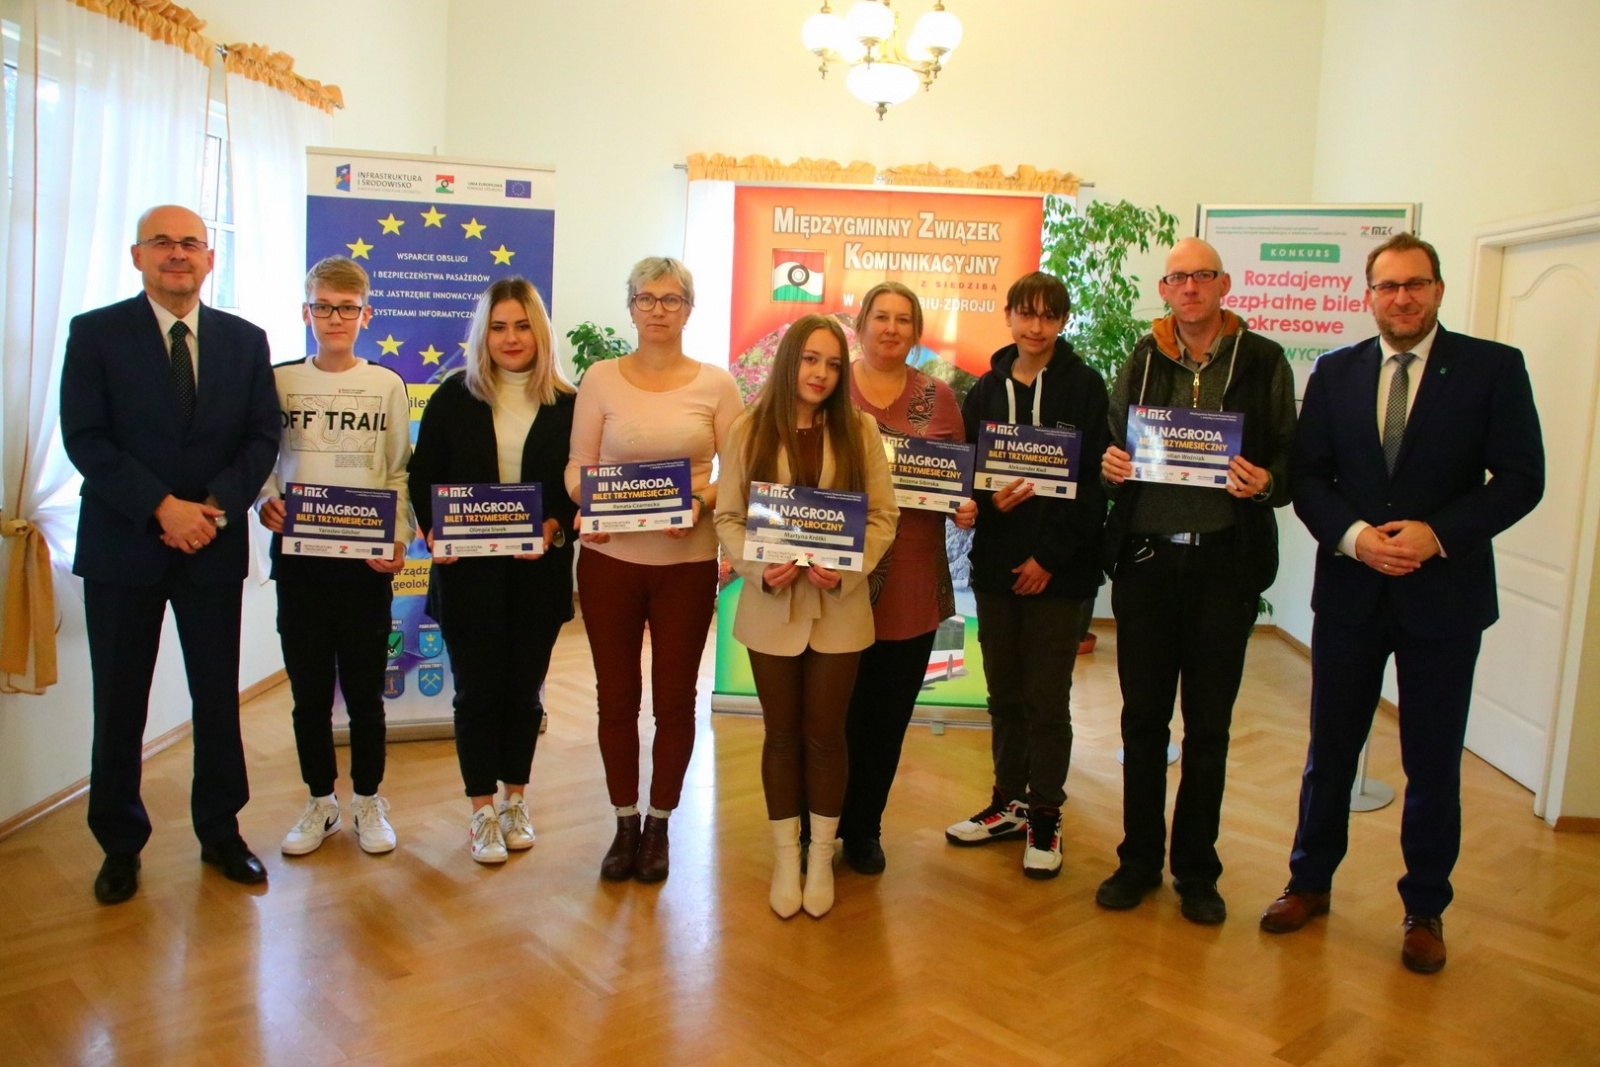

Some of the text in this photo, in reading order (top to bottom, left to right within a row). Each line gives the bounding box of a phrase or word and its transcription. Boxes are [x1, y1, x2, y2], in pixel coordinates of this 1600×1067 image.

[357, 171, 422, 182] INFRASTRUKTURA
[361, 178, 412, 188] ŚRODOWISKO
[773, 206, 1001, 245] MIĘDZYGMINNY ZWIĄZEK
[396, 252, 468, 262] WSPARCIE OBSŁUGI
[843, 242, 1000, 275] KOMUNIKACYJNY
[1270, 248, 1330, 258] KONKURS
[378, 270, 444, 280] BEZPIECZEŃSTWA
[446, 273, 490, 282] PASAŻERÓW
[1244, 270, 1353, 292] Rozdajemy
[921, 280, 998, 292] Z SIEDZIBĄ
[386, 290, 430, 300] JASTRZĘBIE
[433, 292, 483, 300] INNOWACYJN
[842, 293, 855, 307] W
[1322, 295, 1370, 313] bilet
[374, 308, 475, 319] SYSTEMAMI INFORMATYCZN
[1246, 314, 1344, 335] okresowe
[410, 396, 429, 408] ile
[1148, 408, 1172, 422] MZK
[325, 411, 388, 432] TRAIL
[997, 424, 1020, 436] MZK
[1160, 426, 1223, 442] NAGRODA
[994, 439, 1064, 456] III NAGRODA
[897, 453, 957, 470] NAGRODA
[988, 450, 1068, 465] BILET TRZYMIESIĘCZNY
[599, 466, 623, 477] MZK
[899, 464, 962, 479] TRZYMIESIĘCZNY
[1008, 464, 1036, 472] Aleksander
[598, 477, 674, 492] III NAGRODA
[304, 486, 328, 498] MZK
[450, 486, 474, 498] MZK
[592, 488, 680, 500] BILET TRZYMIESIĘCZNY
[770, 485, 796, 500] MZK
[302, 502, 378, 518] III NAGRODA
[450, 502, 525, 514] III NAGRODA
[780, 505, 846, 523] NAGRODA
[296, 514, 384, 526] BILET TRZYMIESIĘCZNY
[444, 513, 530, 523] BILET TRZYMIESIĘCZNY
[792, 518, 844, 532] PÓŁROCZNY
[784, 532, 808, 540] Martyna
[393, 579, 428, 591] geolok
